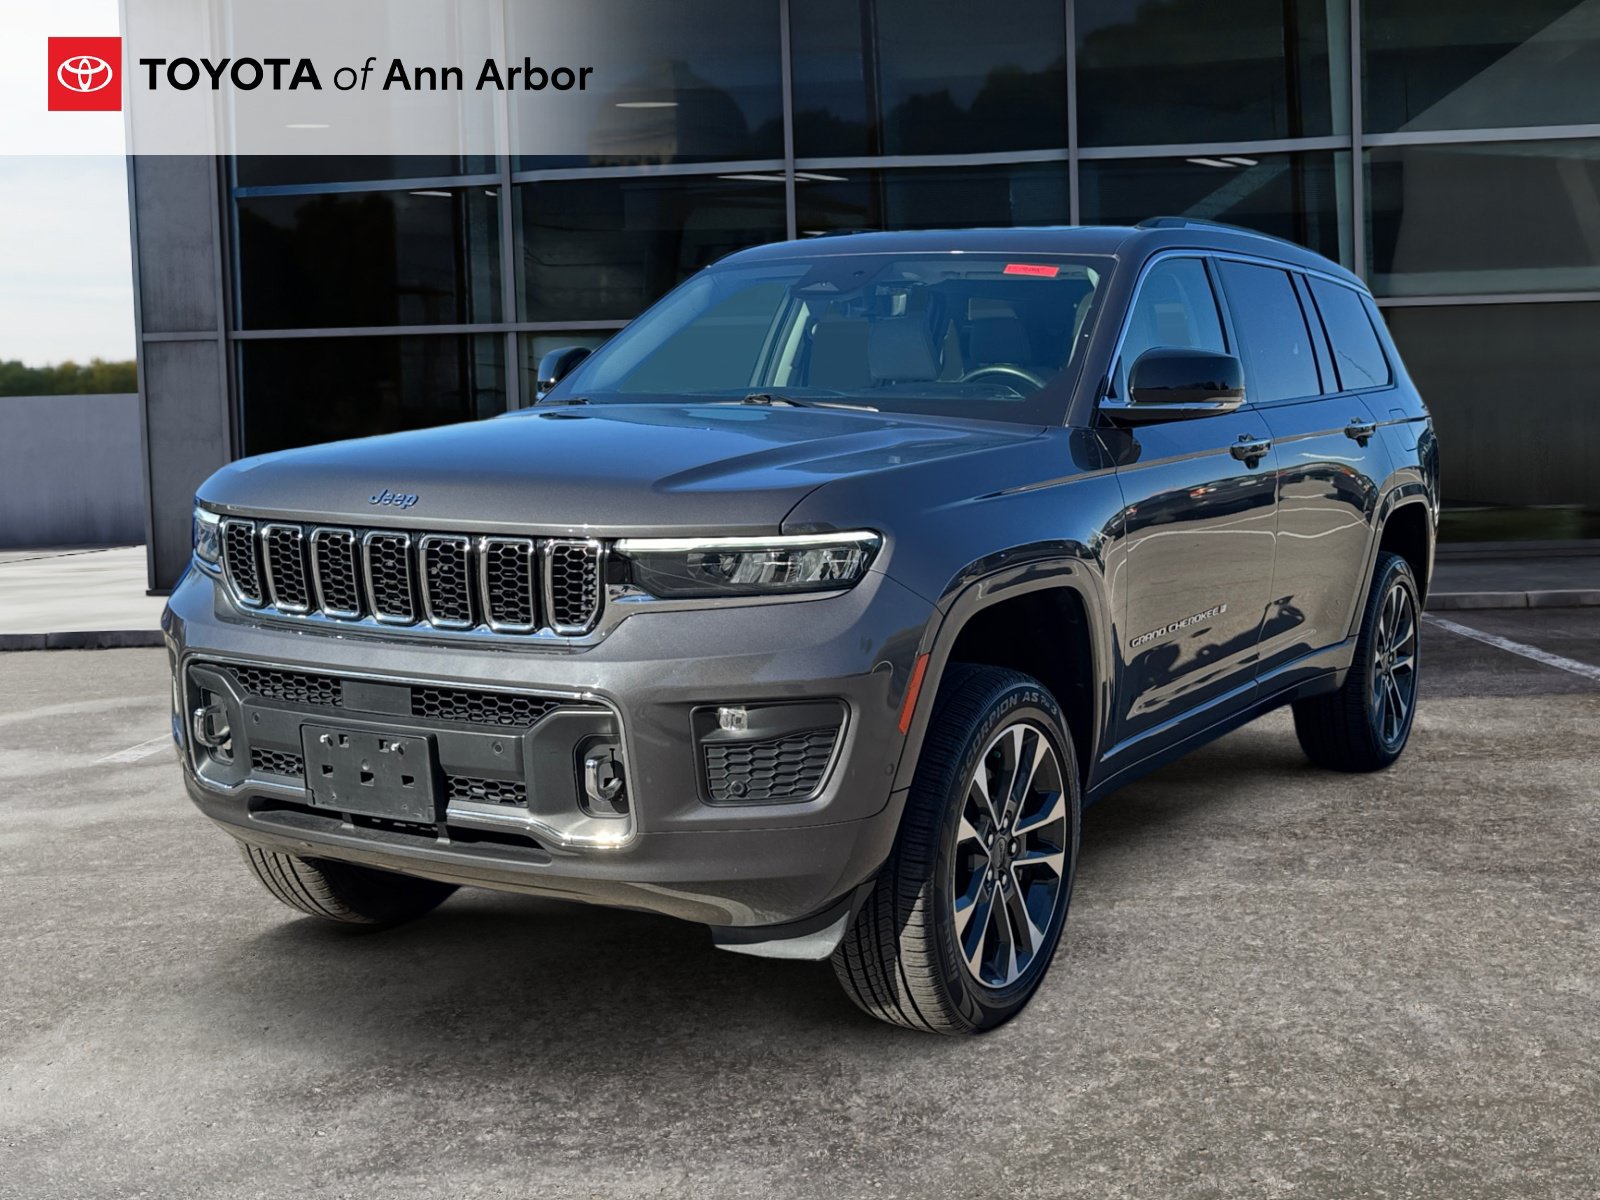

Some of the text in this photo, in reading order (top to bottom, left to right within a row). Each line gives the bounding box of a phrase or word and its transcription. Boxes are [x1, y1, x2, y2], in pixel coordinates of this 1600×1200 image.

[368, 488, 419, 510] Jeep
[1130, 627, 1167, 648] GRAND
[1167, 606, 1219, 633] CHEROKEE
[958, 693, 1018, 787] SCORPION
[1022, 691, 1039, 703] AS
